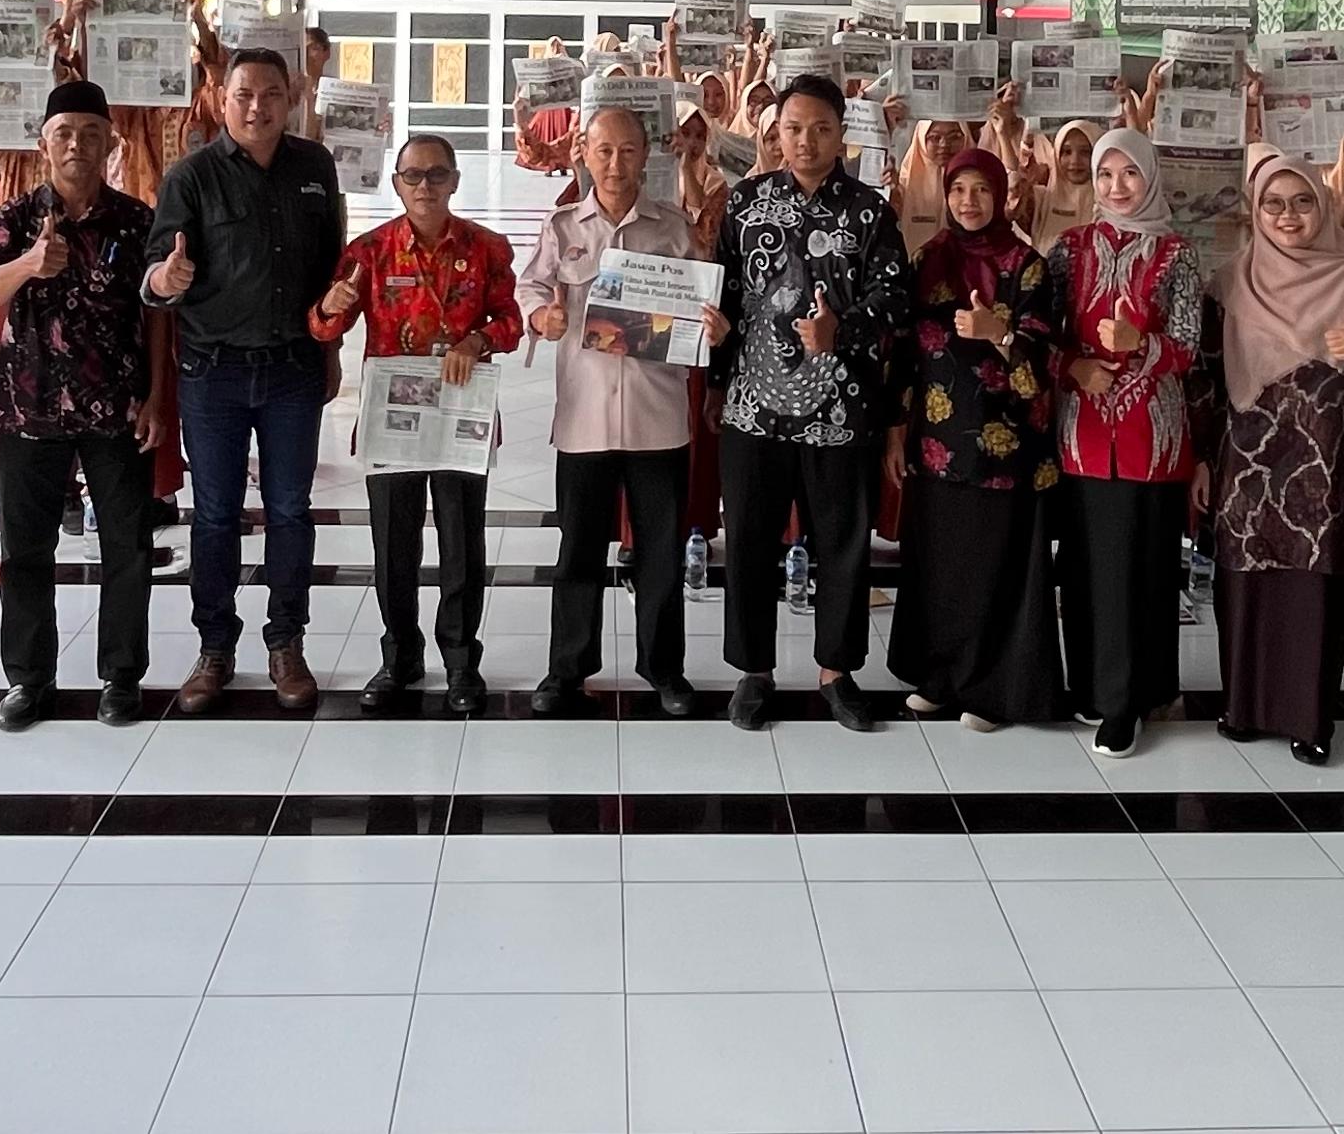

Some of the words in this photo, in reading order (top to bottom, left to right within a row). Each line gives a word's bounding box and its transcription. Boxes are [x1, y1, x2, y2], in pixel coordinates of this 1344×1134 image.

[593, 81, 627, 91] RADAR
[628, 81, 658, 90] KEDIRI
[621, 259, 656, 272] Jawa
[661, 264, 684, 275] Pos
